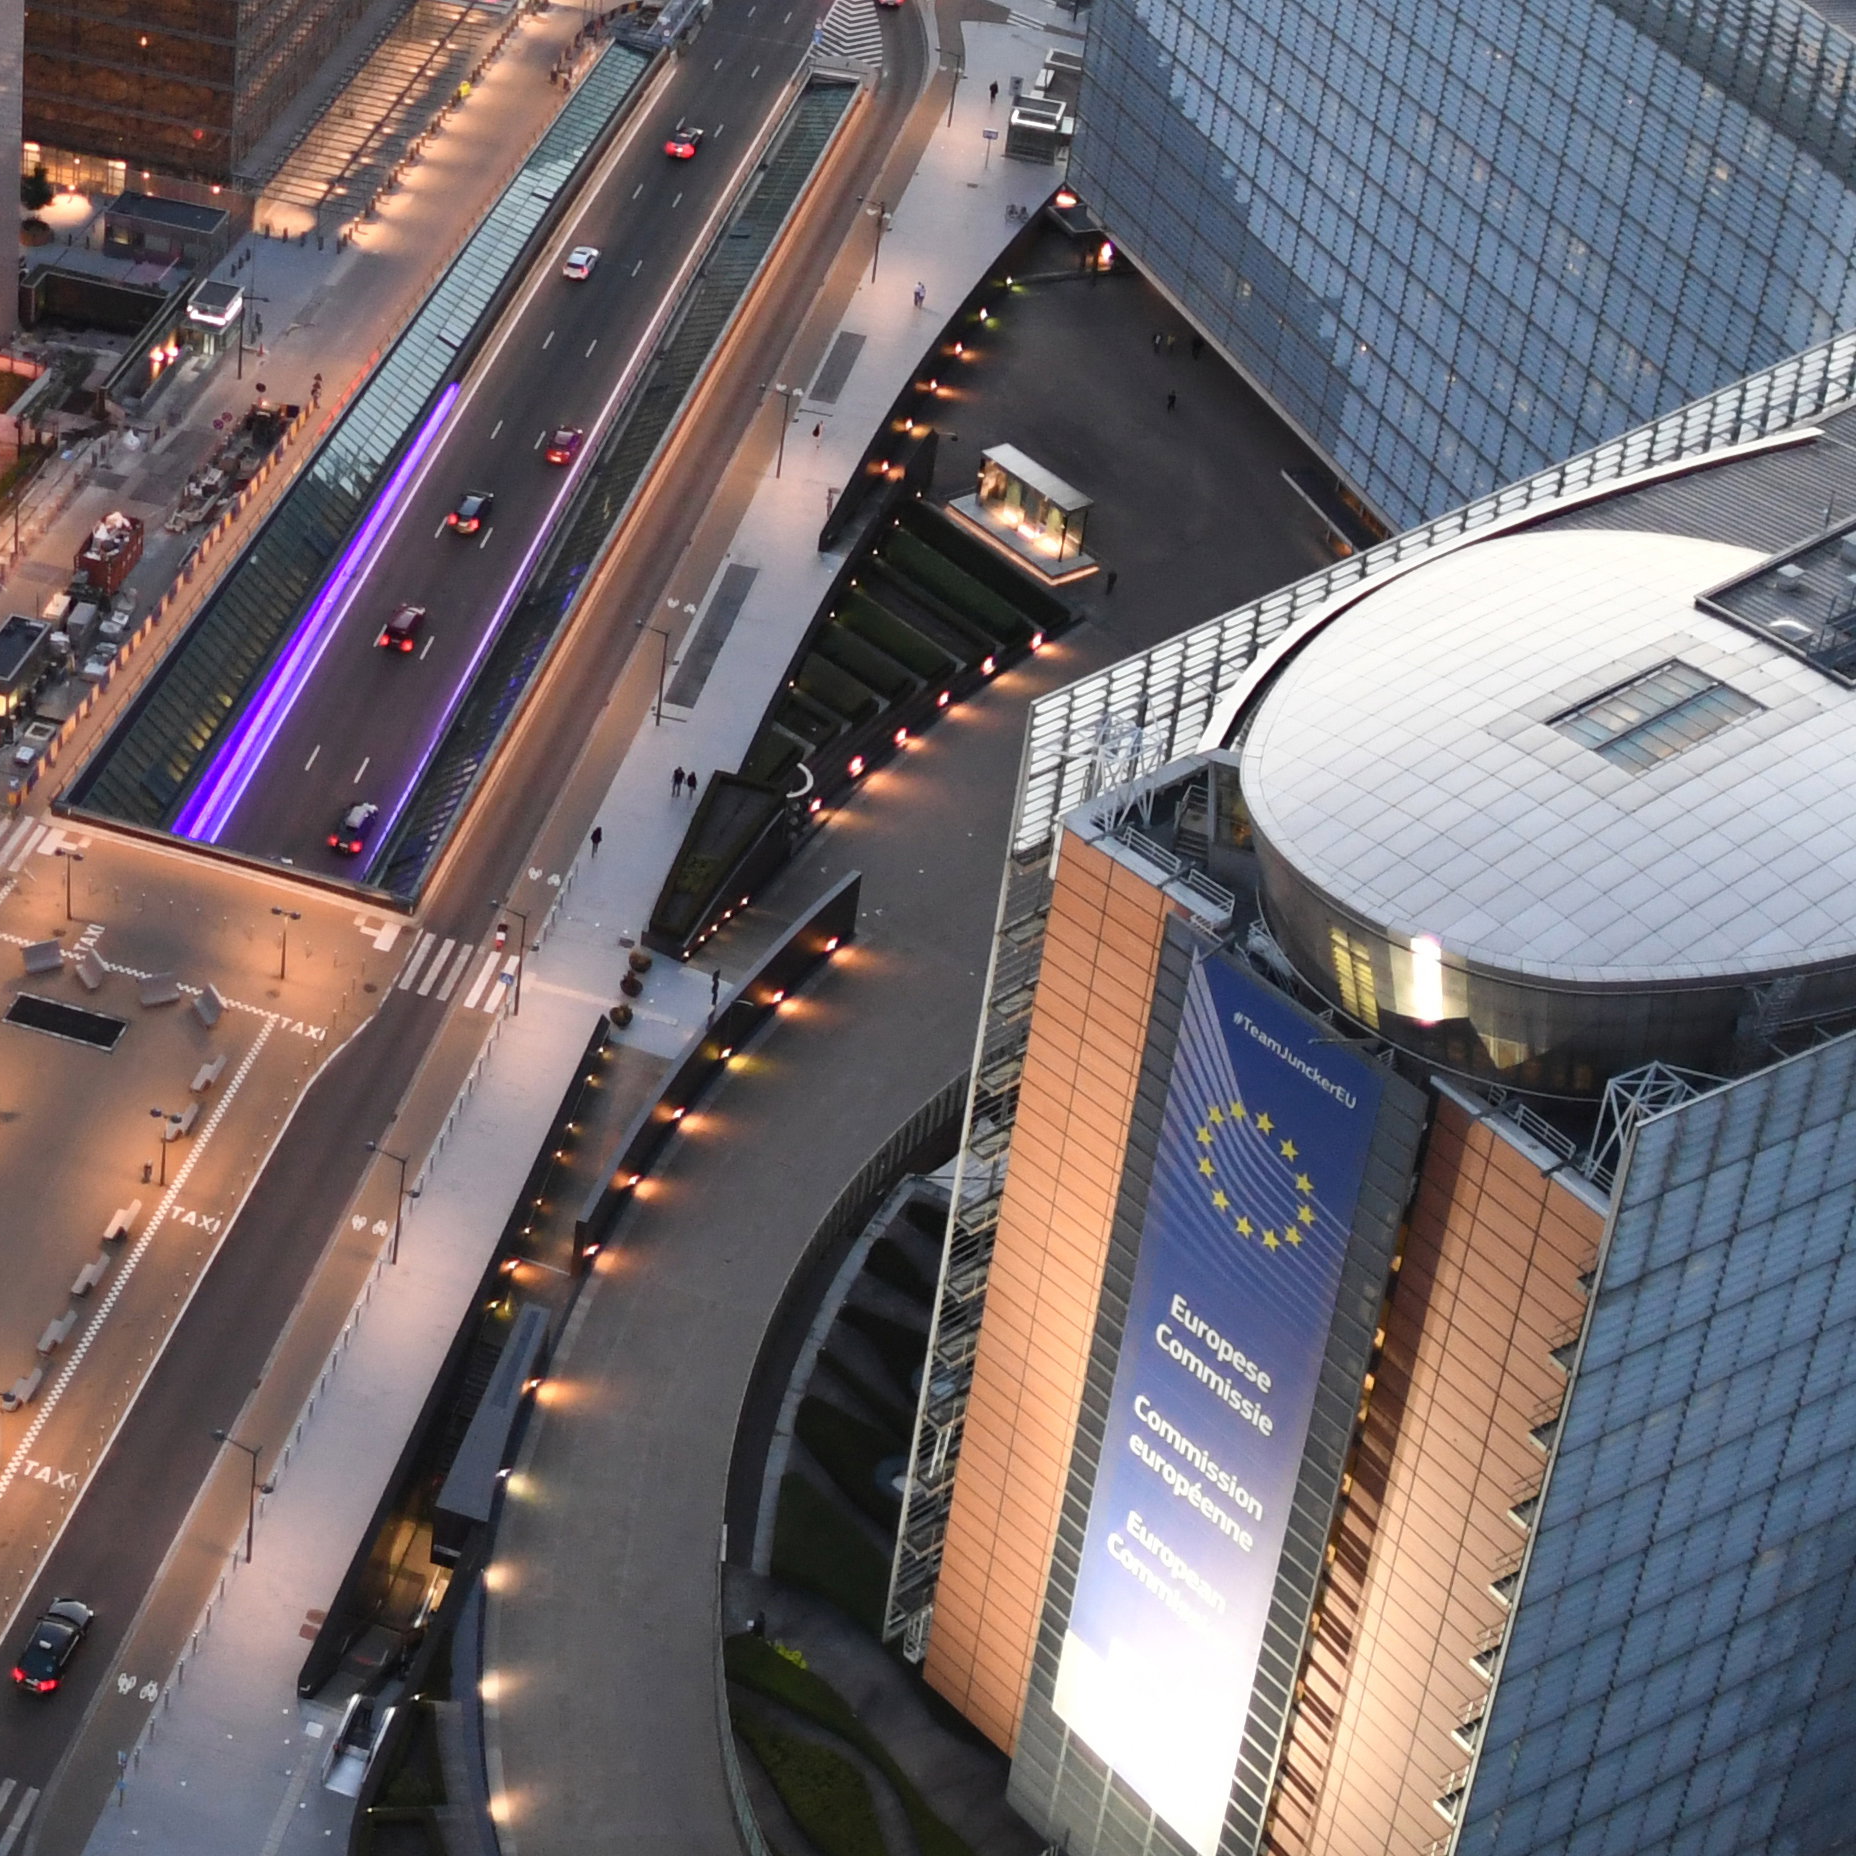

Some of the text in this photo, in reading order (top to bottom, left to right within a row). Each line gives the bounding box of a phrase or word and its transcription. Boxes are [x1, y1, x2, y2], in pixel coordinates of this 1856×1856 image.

[73, 924, 105, 951] TAXI
[281, 1016, 327, 1041] TAXI
[1233, 1011, 1357, 1109] #TeamJunckerEU
[172, 1205, 221, 1234] TAXI
[1156, 1323, 1273, 1436] Commissie
[1171, 1294, 1271, 1393] Europese
[24, 1459, 76, 1492] TAXI
[1129, 1434, 1253, 1552] européenne
[1134, 1395, 1263, 1521] Commission
[1127, 1510, 1227, 1615] European
